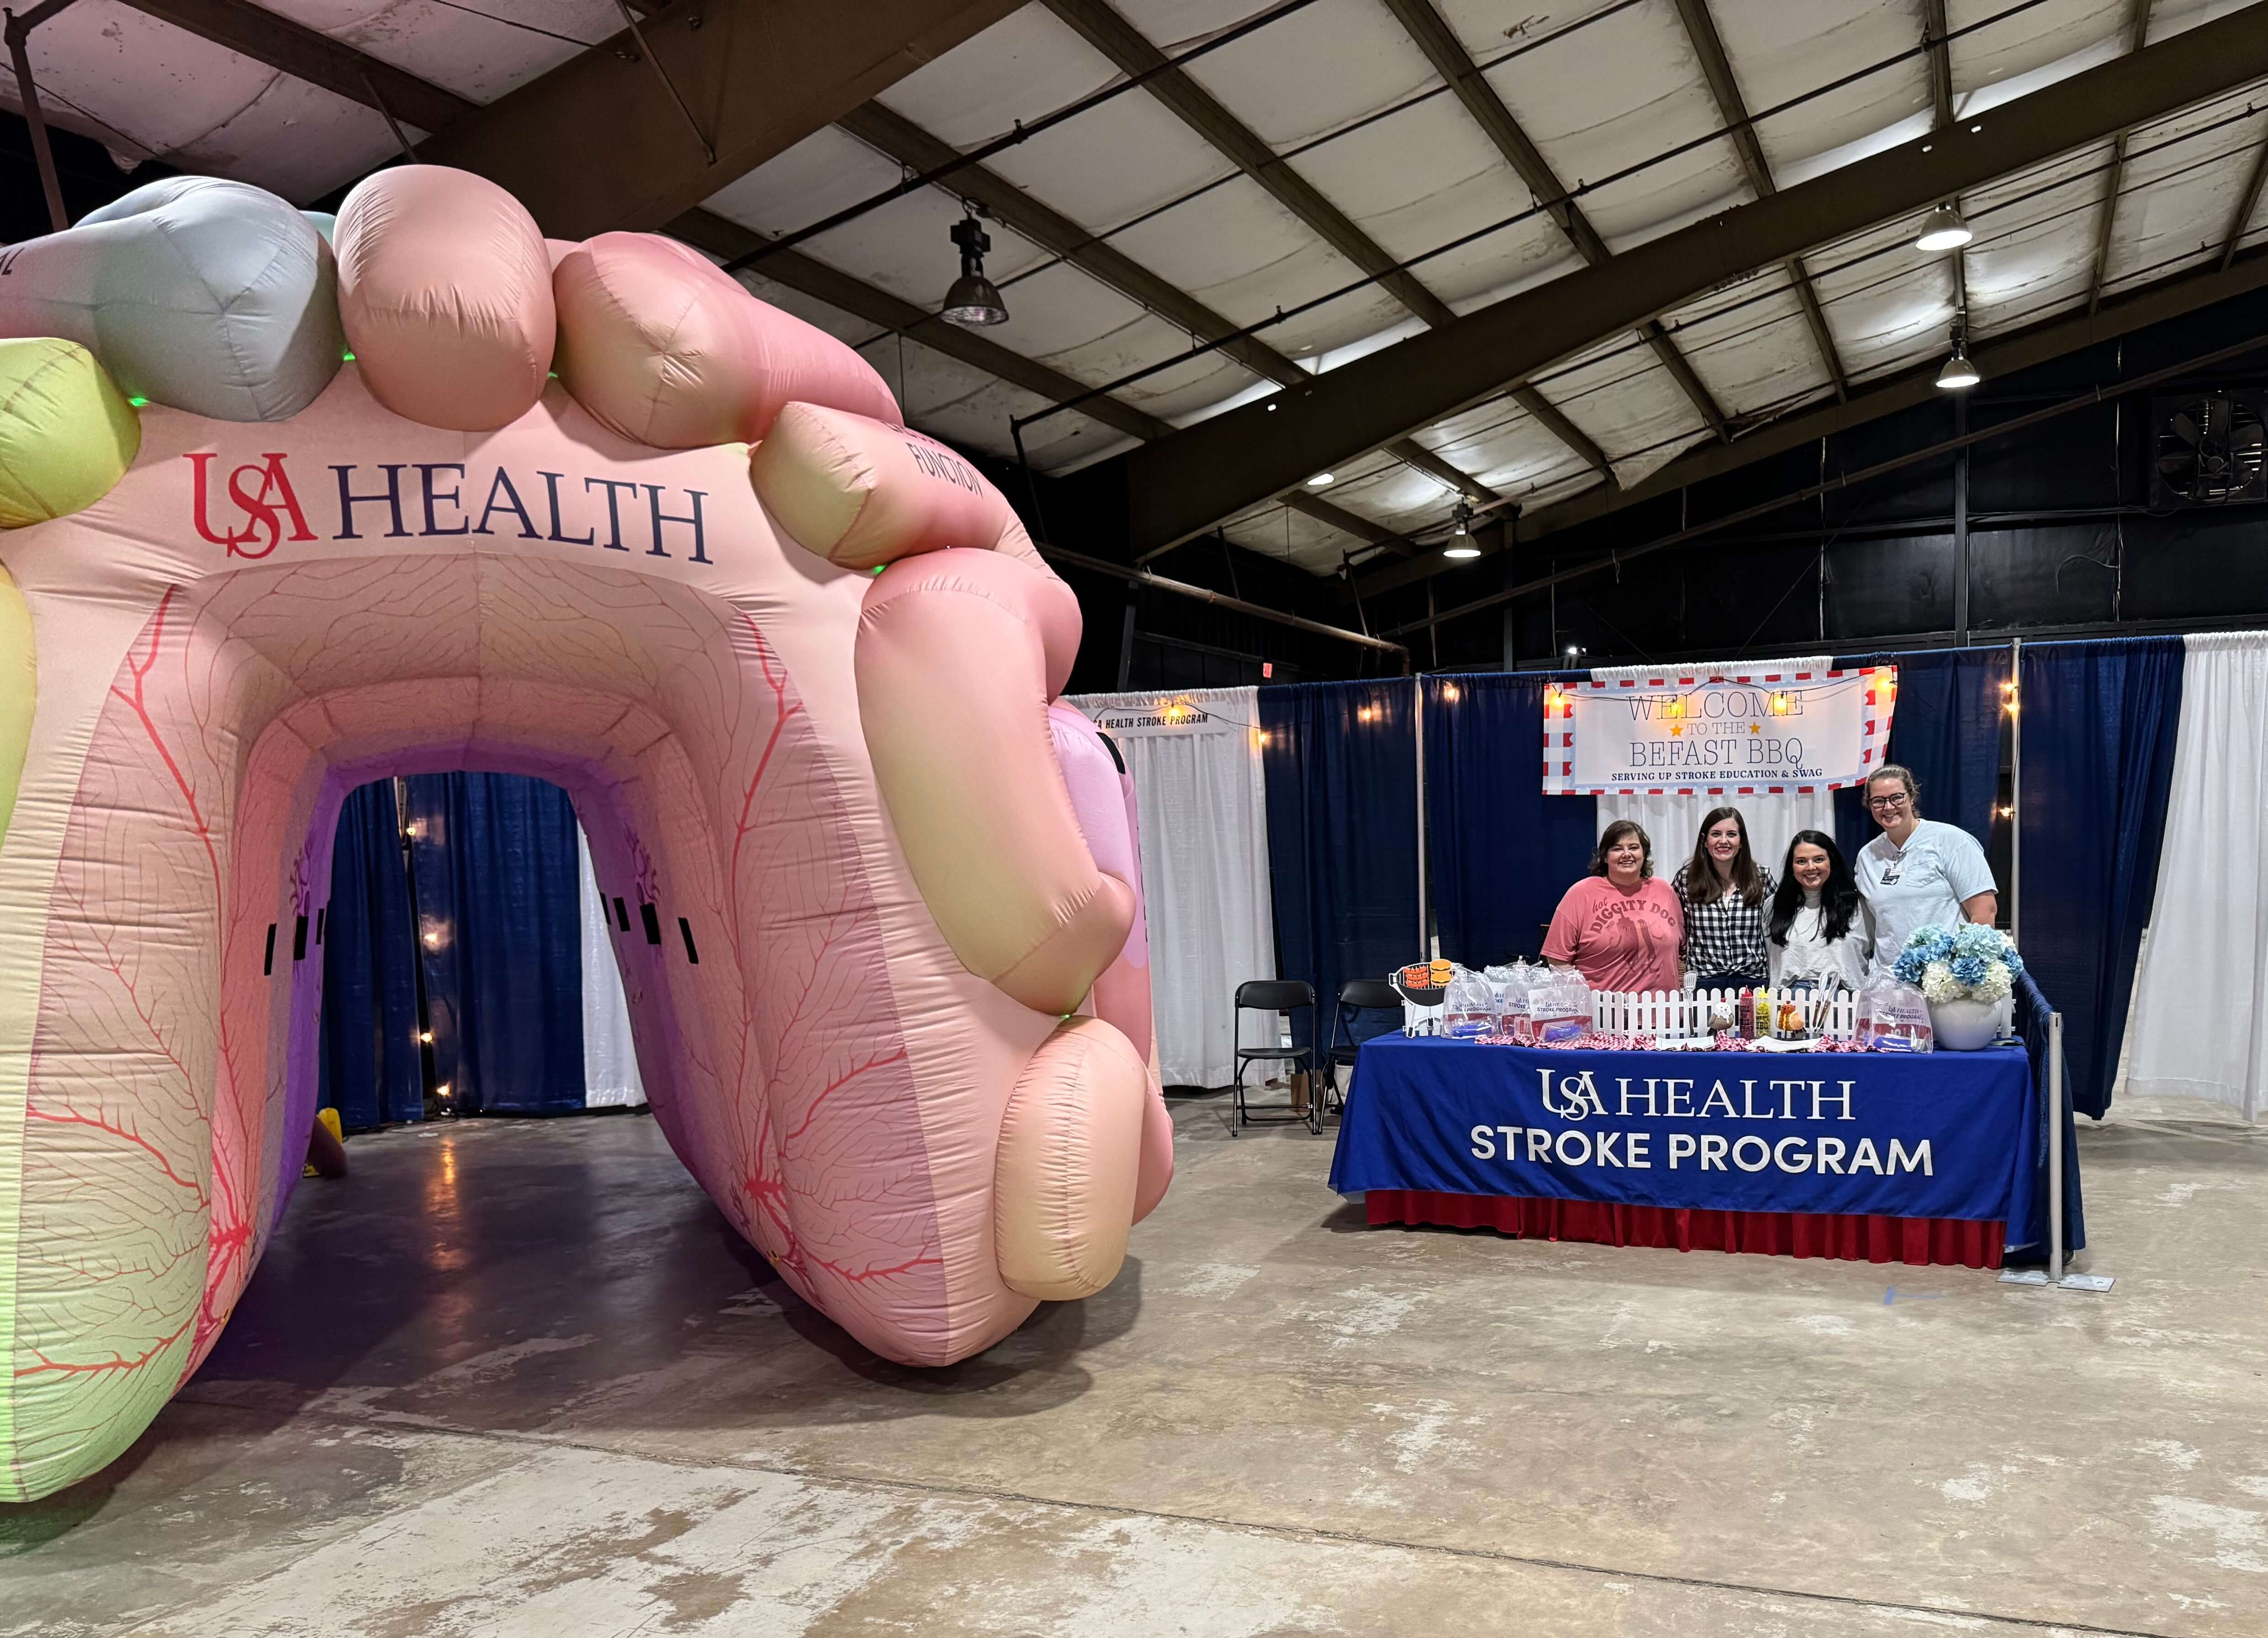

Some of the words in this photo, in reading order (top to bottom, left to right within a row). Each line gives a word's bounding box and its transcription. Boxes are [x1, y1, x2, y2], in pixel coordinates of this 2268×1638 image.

[906, 442, 983, 500] FUNCTION
[183, 453, 318, 559] USA
[327, 463, 714, 565] HEALTH
[1106, 718, 1134, 729] HEALTH
[1137, 716, 1166, 727] STROKE
[1170, 713, 1208, 725] PROGRAM
[1626, 690, 1804, 721] WELCOME
[1687, 722, 1707, 735] TO
[1712, 722, 1745, 735] THE
[1630, 739, 1736, 767] BEFAST
[1746, 738, 1803, 769] BBQ
[1611, 772, 1655, 781] SERVING
[1659, 772, 1672, 780] UP
[1676, 771, 1716, 779] STROKE
[1720, 770, 1778, 779] EDUCATION
[1793, 769, 1823, 777] SWAG
[1589, 900, 1647, 934] DIGGITY
[1649, 902, 1676, 927] DOG
[1593, 896, 1608, 914] hot
[1535, 1069, 1609, 1121] USA
[1615, 1077, 1857, 1120] HEALTH
[1470, 1124, 1651, 1169] STROKE
[1669, 1133, 1934, 1176] PROGRAM
